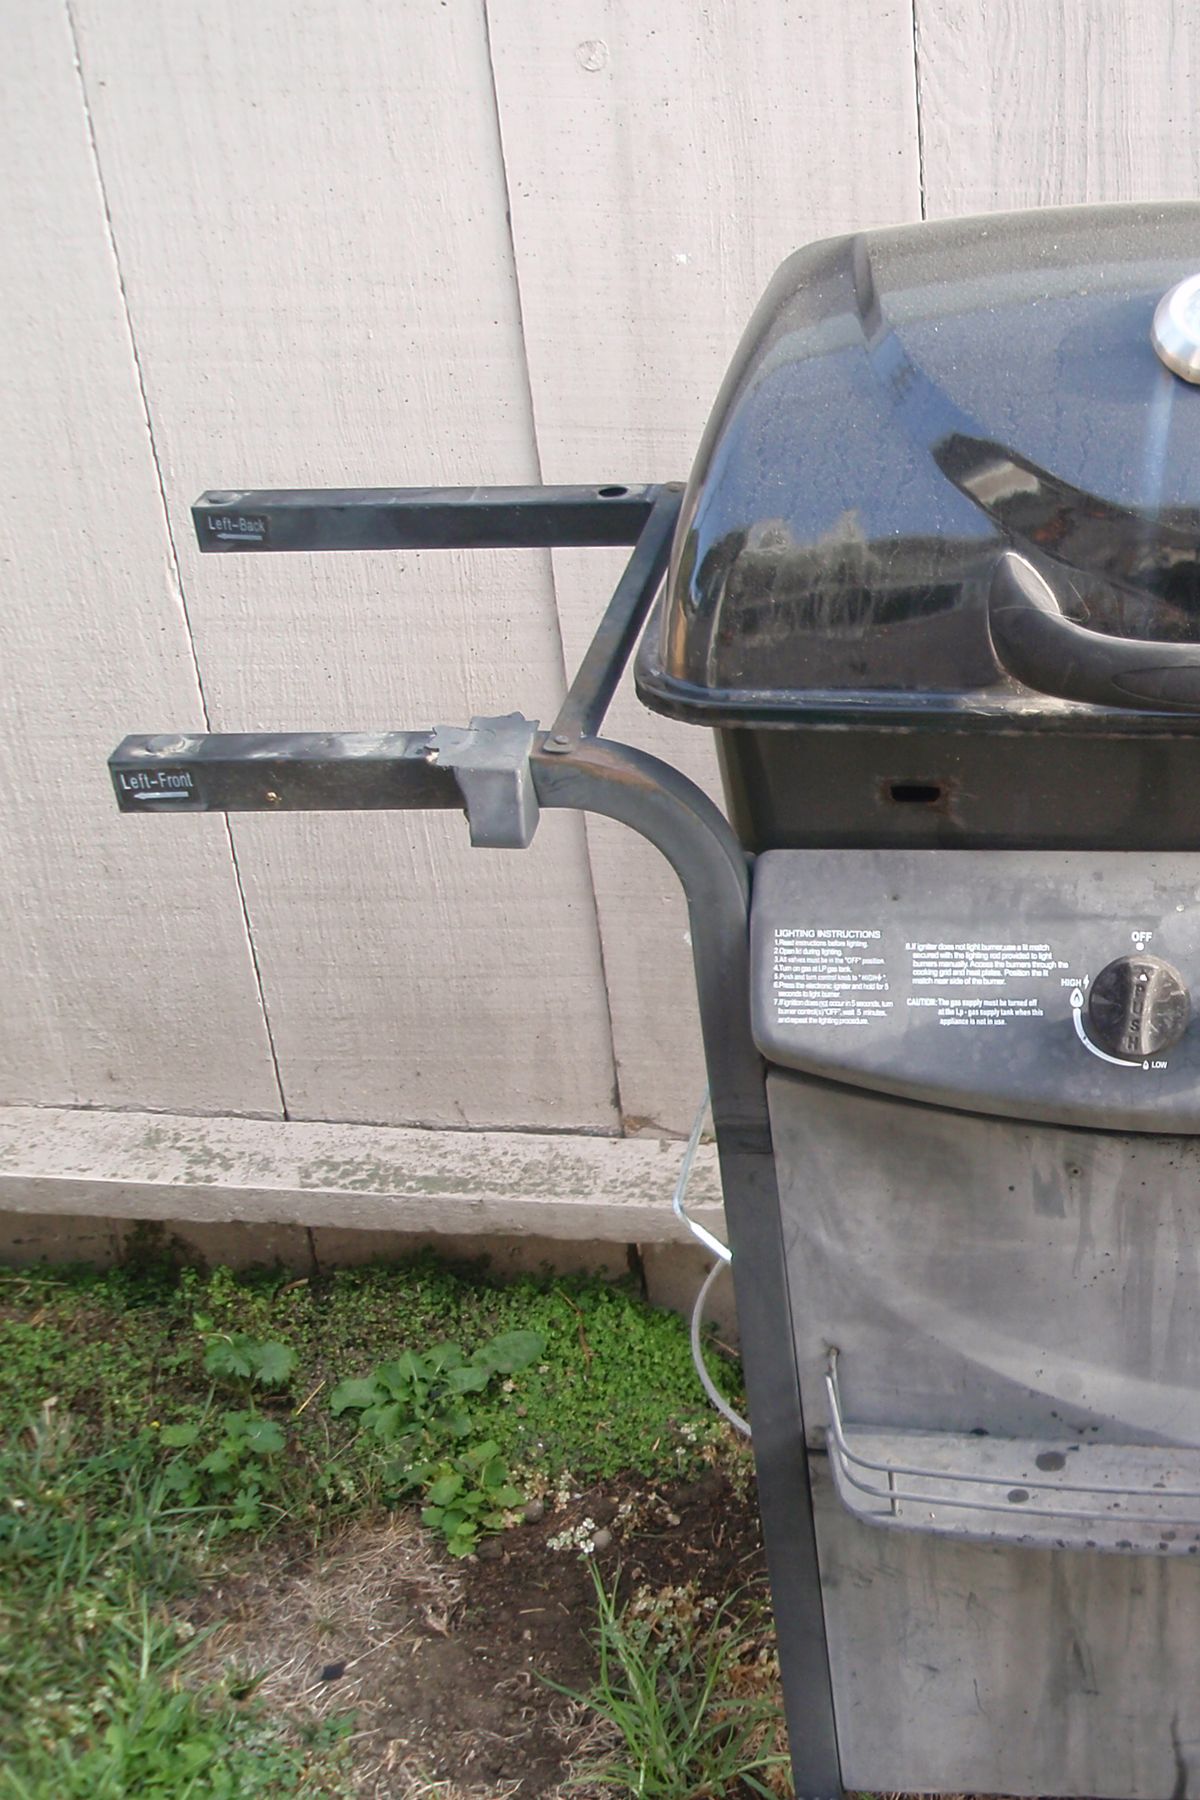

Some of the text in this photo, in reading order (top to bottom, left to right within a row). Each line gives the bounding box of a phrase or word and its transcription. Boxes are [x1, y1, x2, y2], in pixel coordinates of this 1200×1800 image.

[207, 515, 266, 532] Left-Back
[120, 772, 194, 790] Left-Front
[774, 929, 881, 939] LIGHTING INSTRUCTIONS
[1131, 931, 1152, 942] OFF
[1061, 978, 1082, 987] HIGH
[1151, 1060, 1168, 1069] LOW
